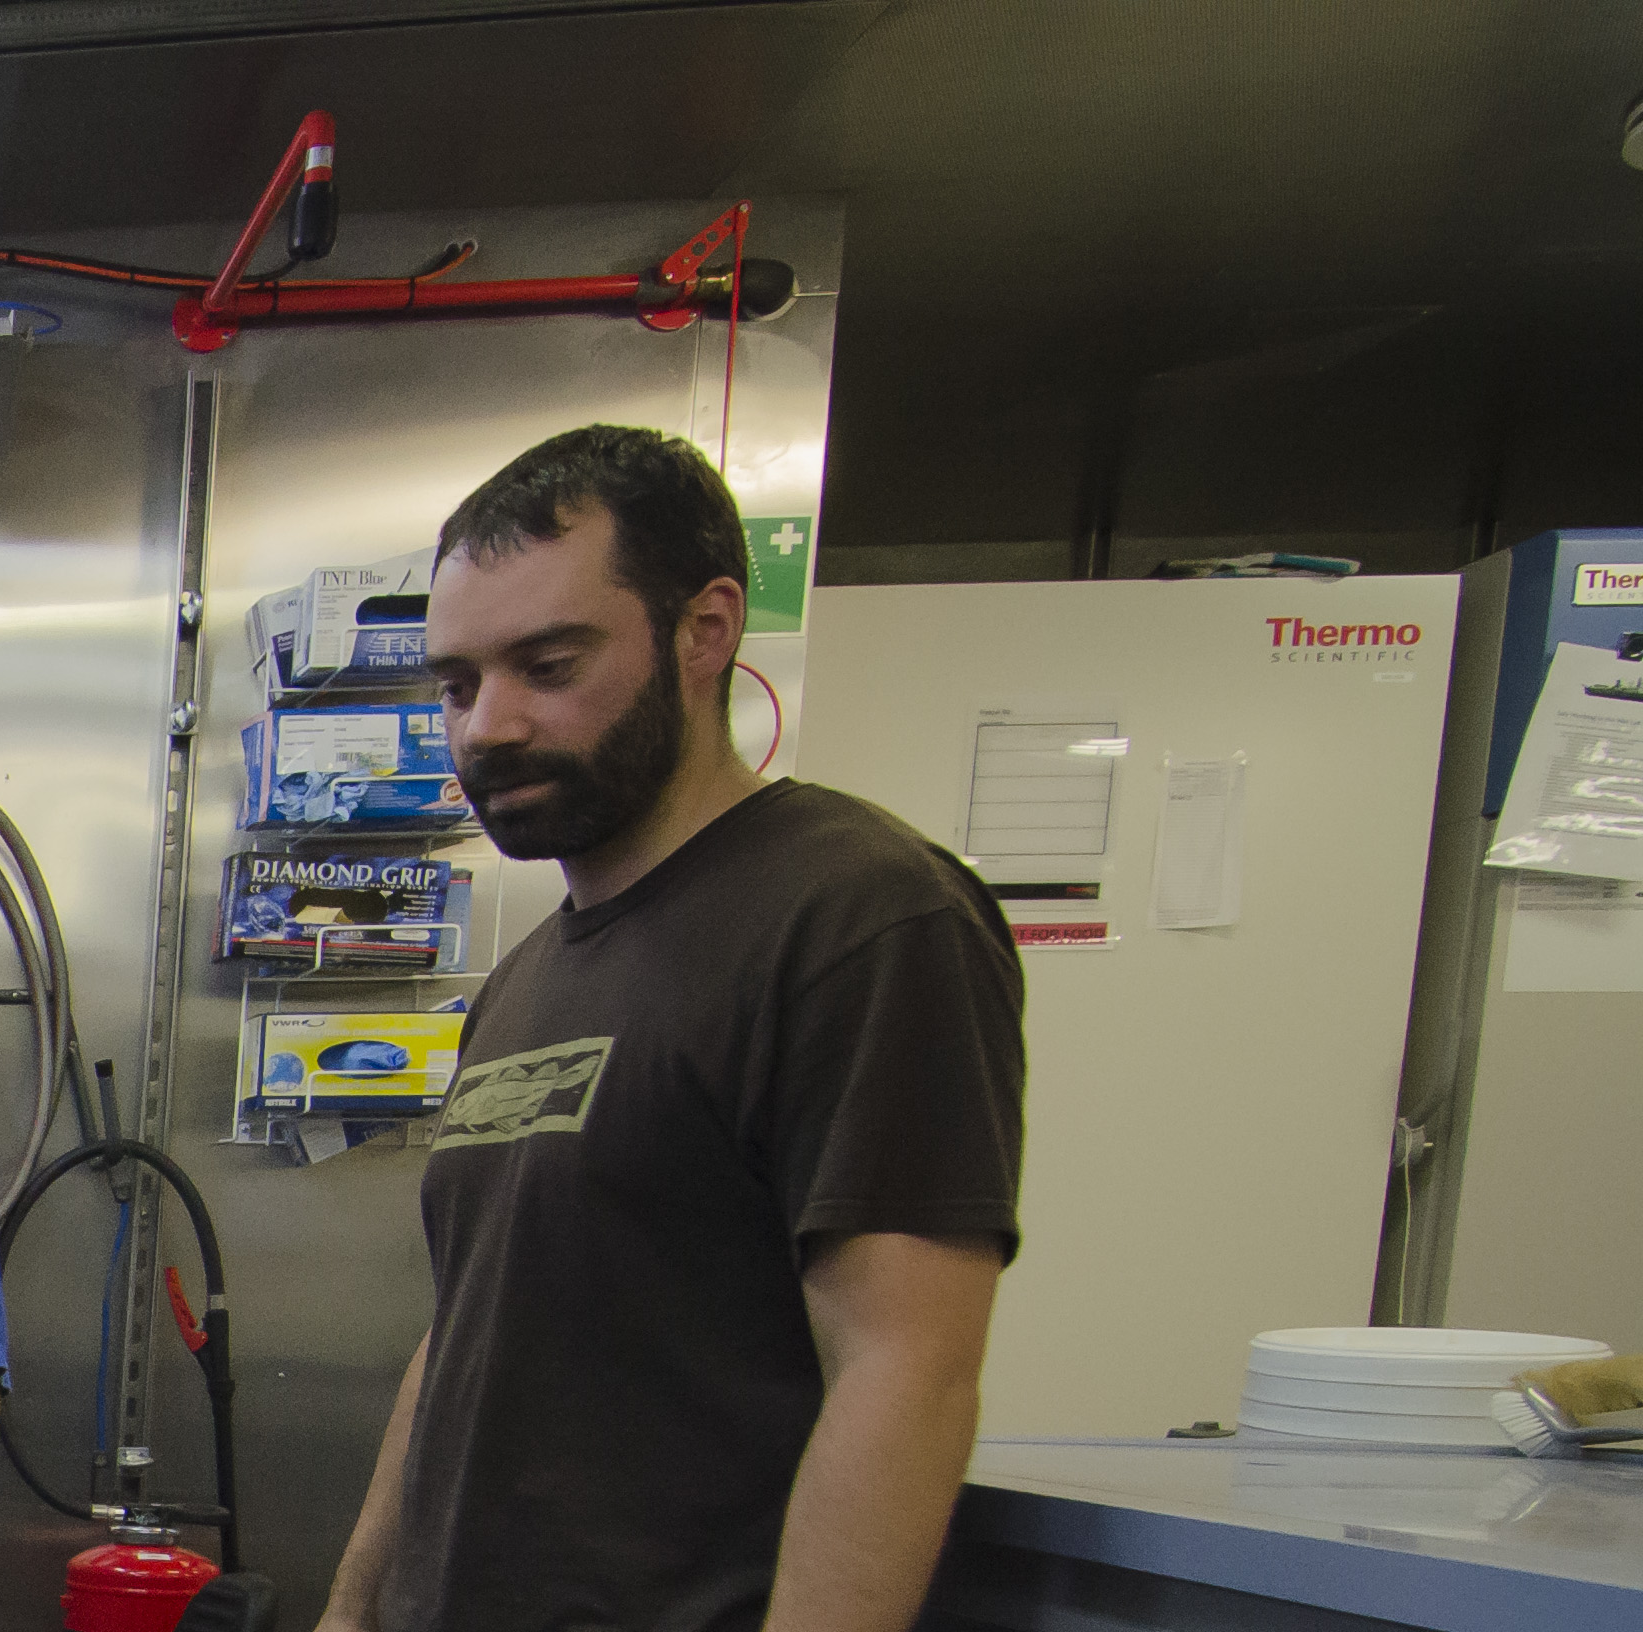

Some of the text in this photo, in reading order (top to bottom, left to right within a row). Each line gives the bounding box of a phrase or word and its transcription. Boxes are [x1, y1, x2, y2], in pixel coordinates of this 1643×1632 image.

[320, 570, 388, 586] TNT Blue
[1266, 617, 1421, 647] Thermo
[376, 634, 427, 654] TN
[368, 655, 425, 667] THIN NIT
[1270, 651, 1416, 663] SCIENTIFIC
[252, 859, 438, 887] DIAMOND GRIP
